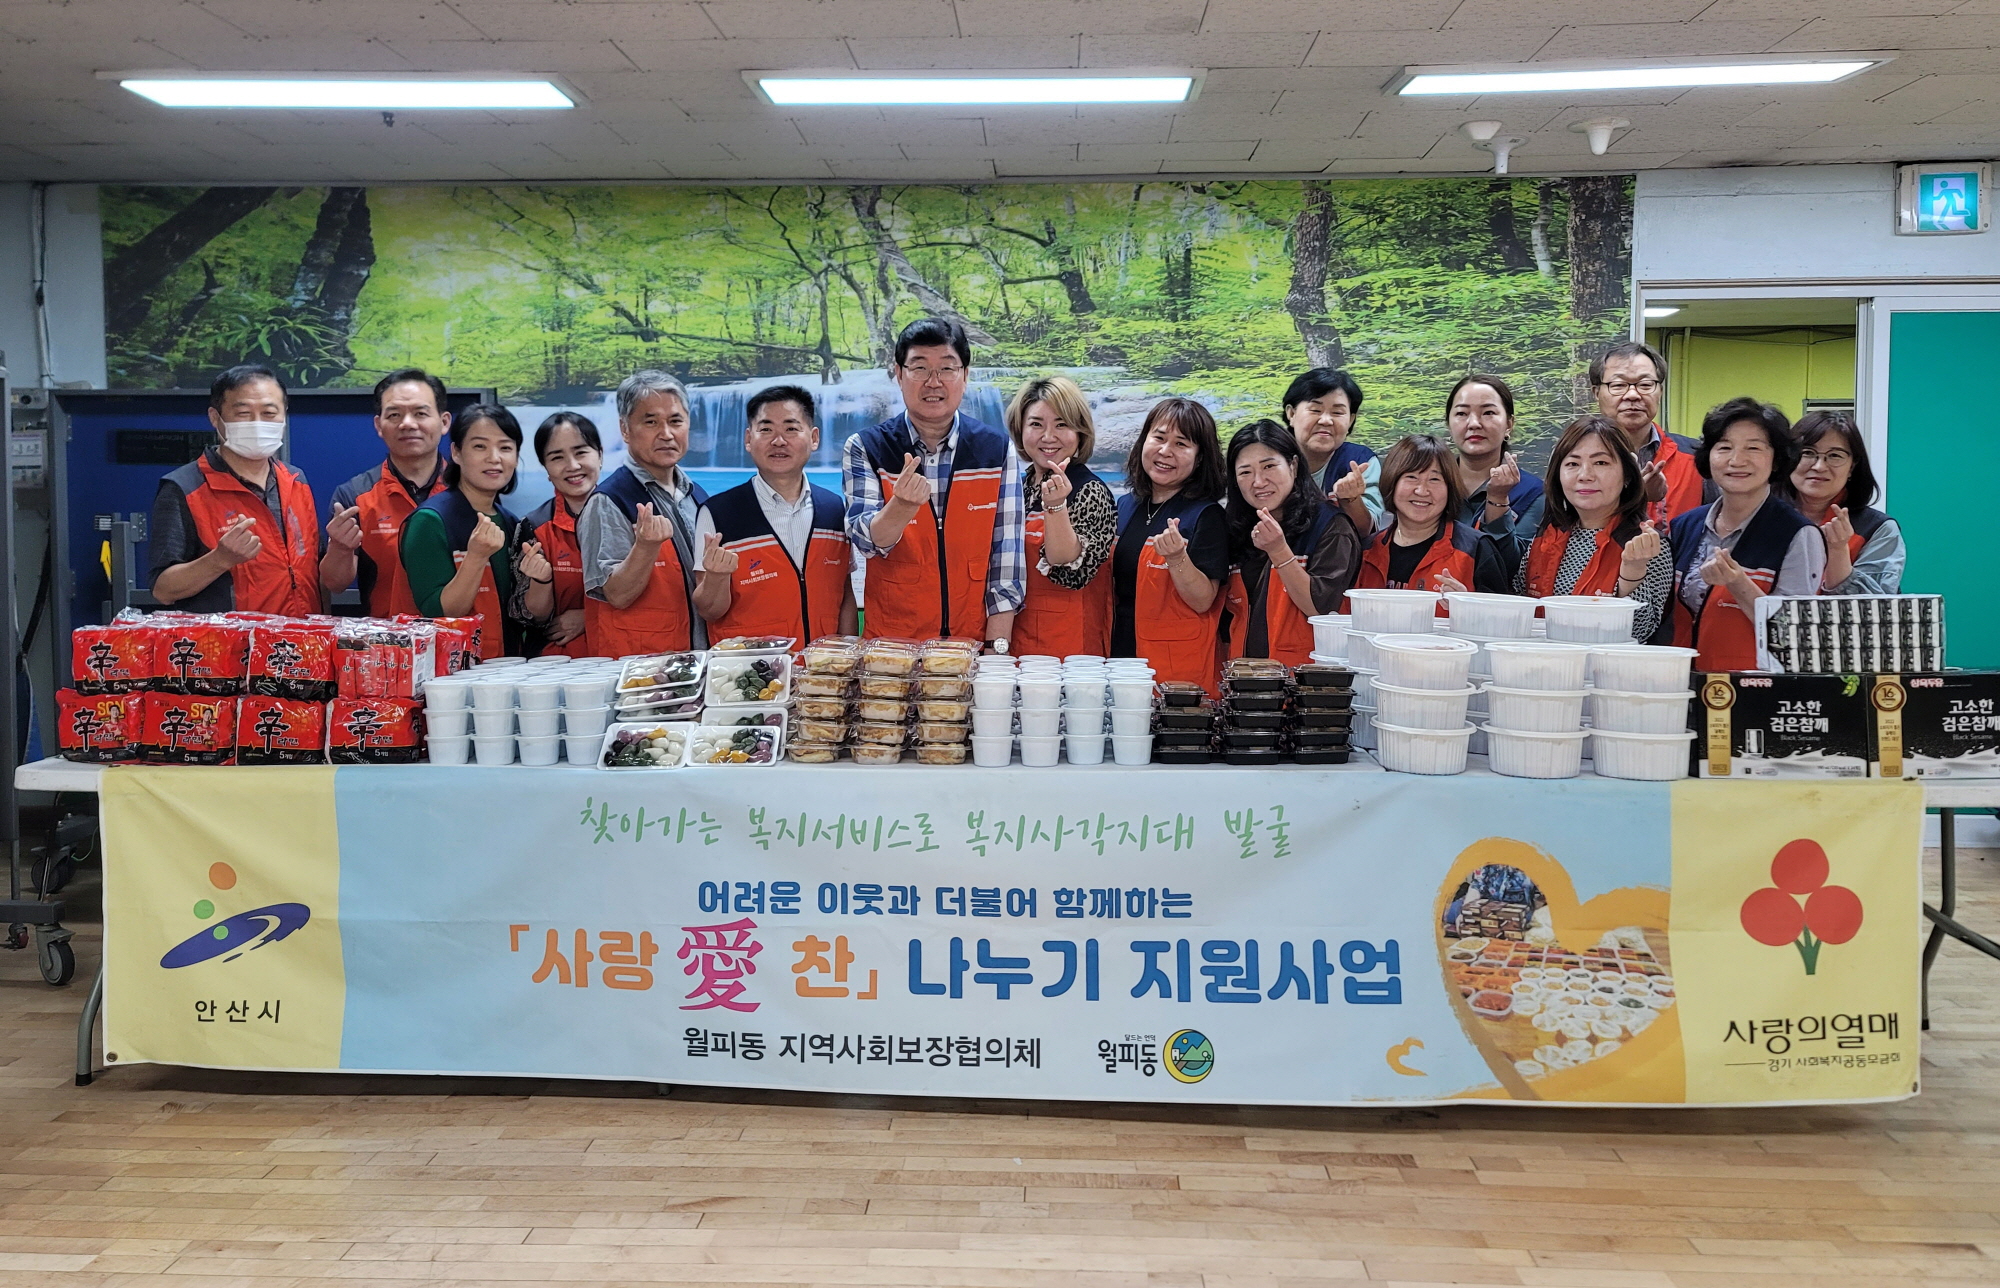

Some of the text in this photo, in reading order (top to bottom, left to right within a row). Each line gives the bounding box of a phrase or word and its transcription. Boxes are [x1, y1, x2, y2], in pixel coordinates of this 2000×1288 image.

[86, 639, 120, 684] 辛
[168, 636, 203, 684] 辛
[267, 638, 303, 683] 辛
[289, 667, 310, 677] 라면
[1776, 700, 1822, 715] 고소한
[1882, 687, 1894, 698] 16
[1948, 699, 1994, 714] 고소한
[72, 706, 105, 752] 辛
[159, 706, 195, 752] 辛
[182, 735, 203, 744] 라면
[254, 706, 291, 754] 辛
[277, 737, 300, 746] 라면
[347, 706, 384, 752] 辛
[371, 735, 393, 744] 라면
[1770, 717, 1829, 733] 검은참깨
[1942, 716, 2000, 732] 검은참깨
[580, 796, 1291, 859] 찾아가는 복지서비스로 복지사각지대 발굴
[698, 881, 1193, 919] 어려운 이웃과 더불어 함께하는
[676, 917, 764, 1013] 愛
[908, 937, 1099, 1001] 나누기
[1130, 938, 1402, 1004] 지원사업
[195, 999, 281, 1023] 안산시
[683, 1026, 1042, 1069] 월피동 지역사회보장협의체
[1722, 1012, 1899, 1054] 사랑의열매
[1098, 1039, 1158, 1077] 월피동
[1768, 1052, 1901, 1073] 경기 사회복지공동모금회
